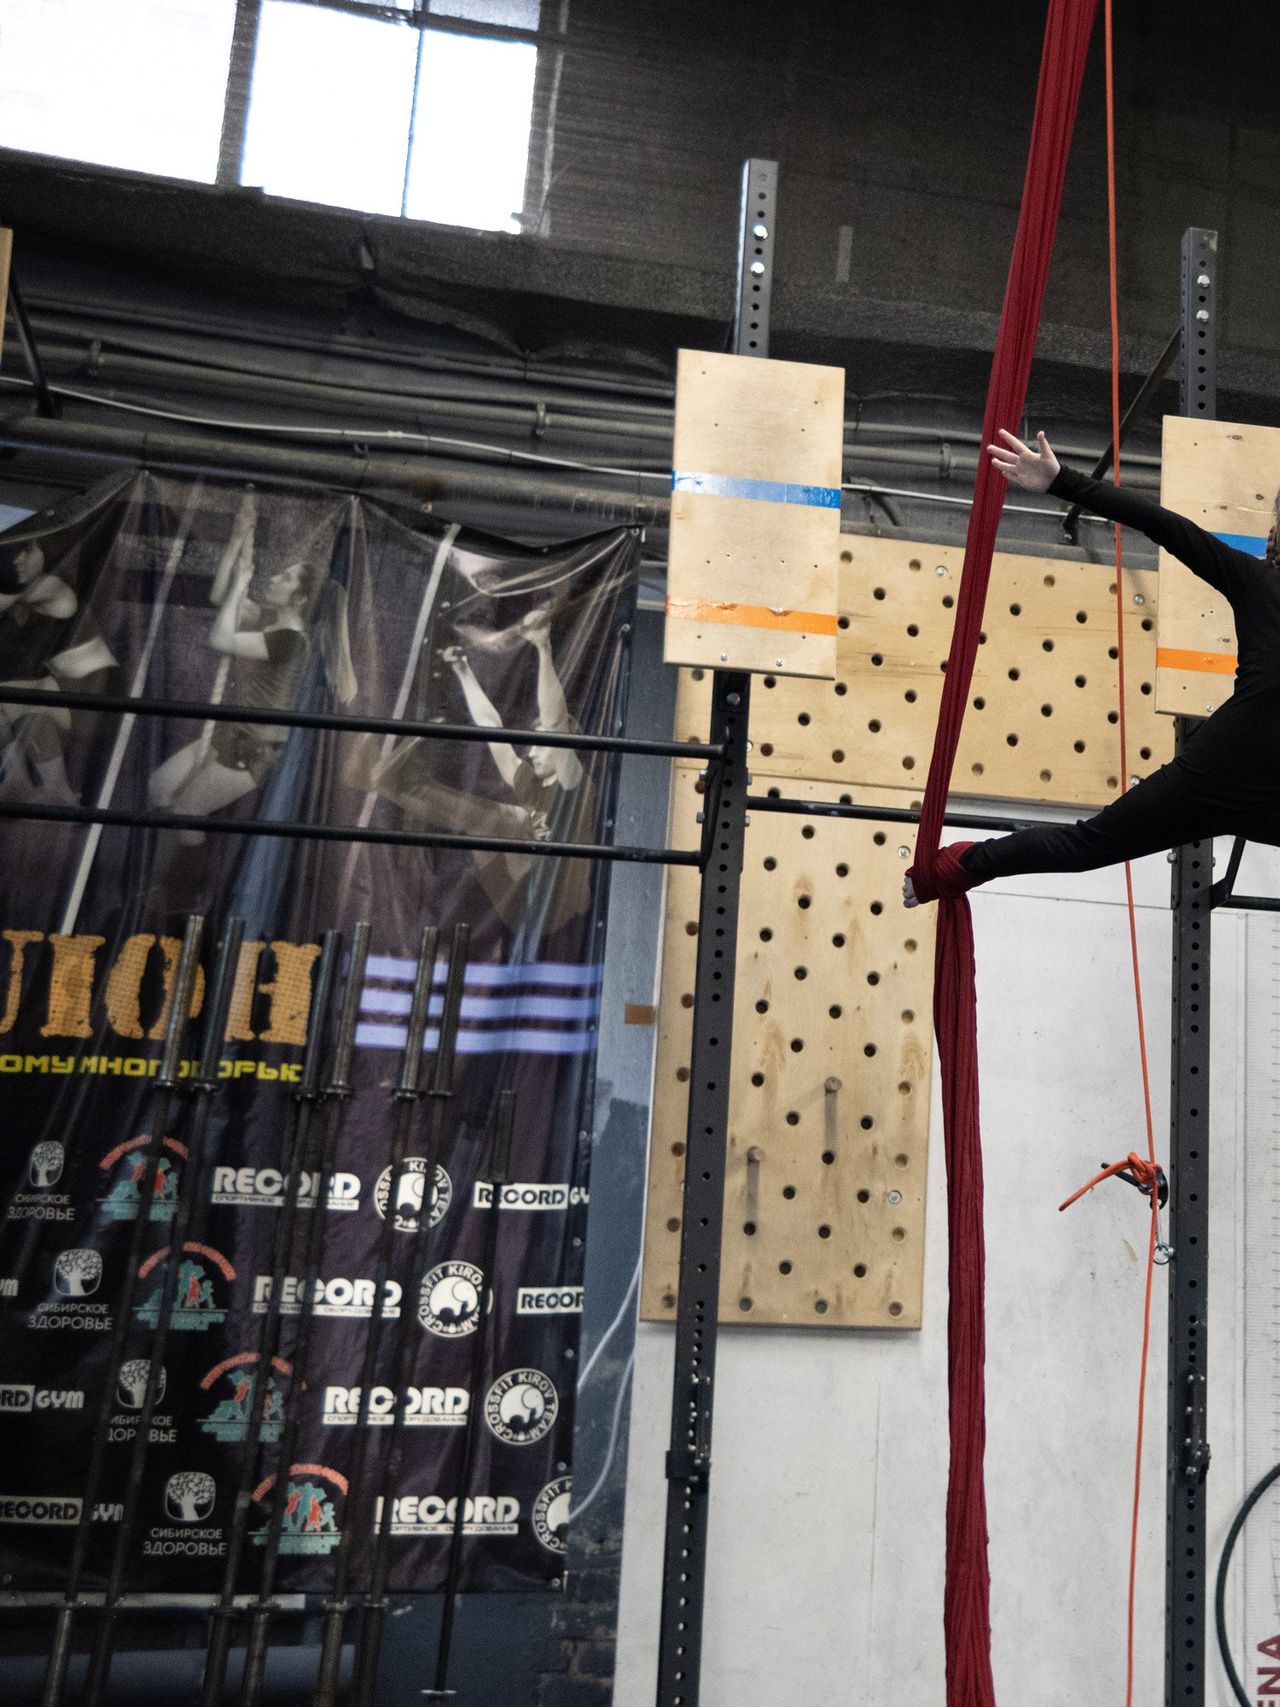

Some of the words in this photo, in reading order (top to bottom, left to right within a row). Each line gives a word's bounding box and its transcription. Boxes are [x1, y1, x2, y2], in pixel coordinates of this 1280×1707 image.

[479, 1188, 565, 1205] RCORD
[37, 1302, 110, 1315] СИБИРСКОЕ
[27, 1315, 114, 1331] ЗДОРОВЬЕ
[36, 1390, 85, 1409] GYM
[150, 1527, 223, 1539] СИБИРСКОЕ
[143, 1541, 228, 1556] ЗДОРОВЬЕ
